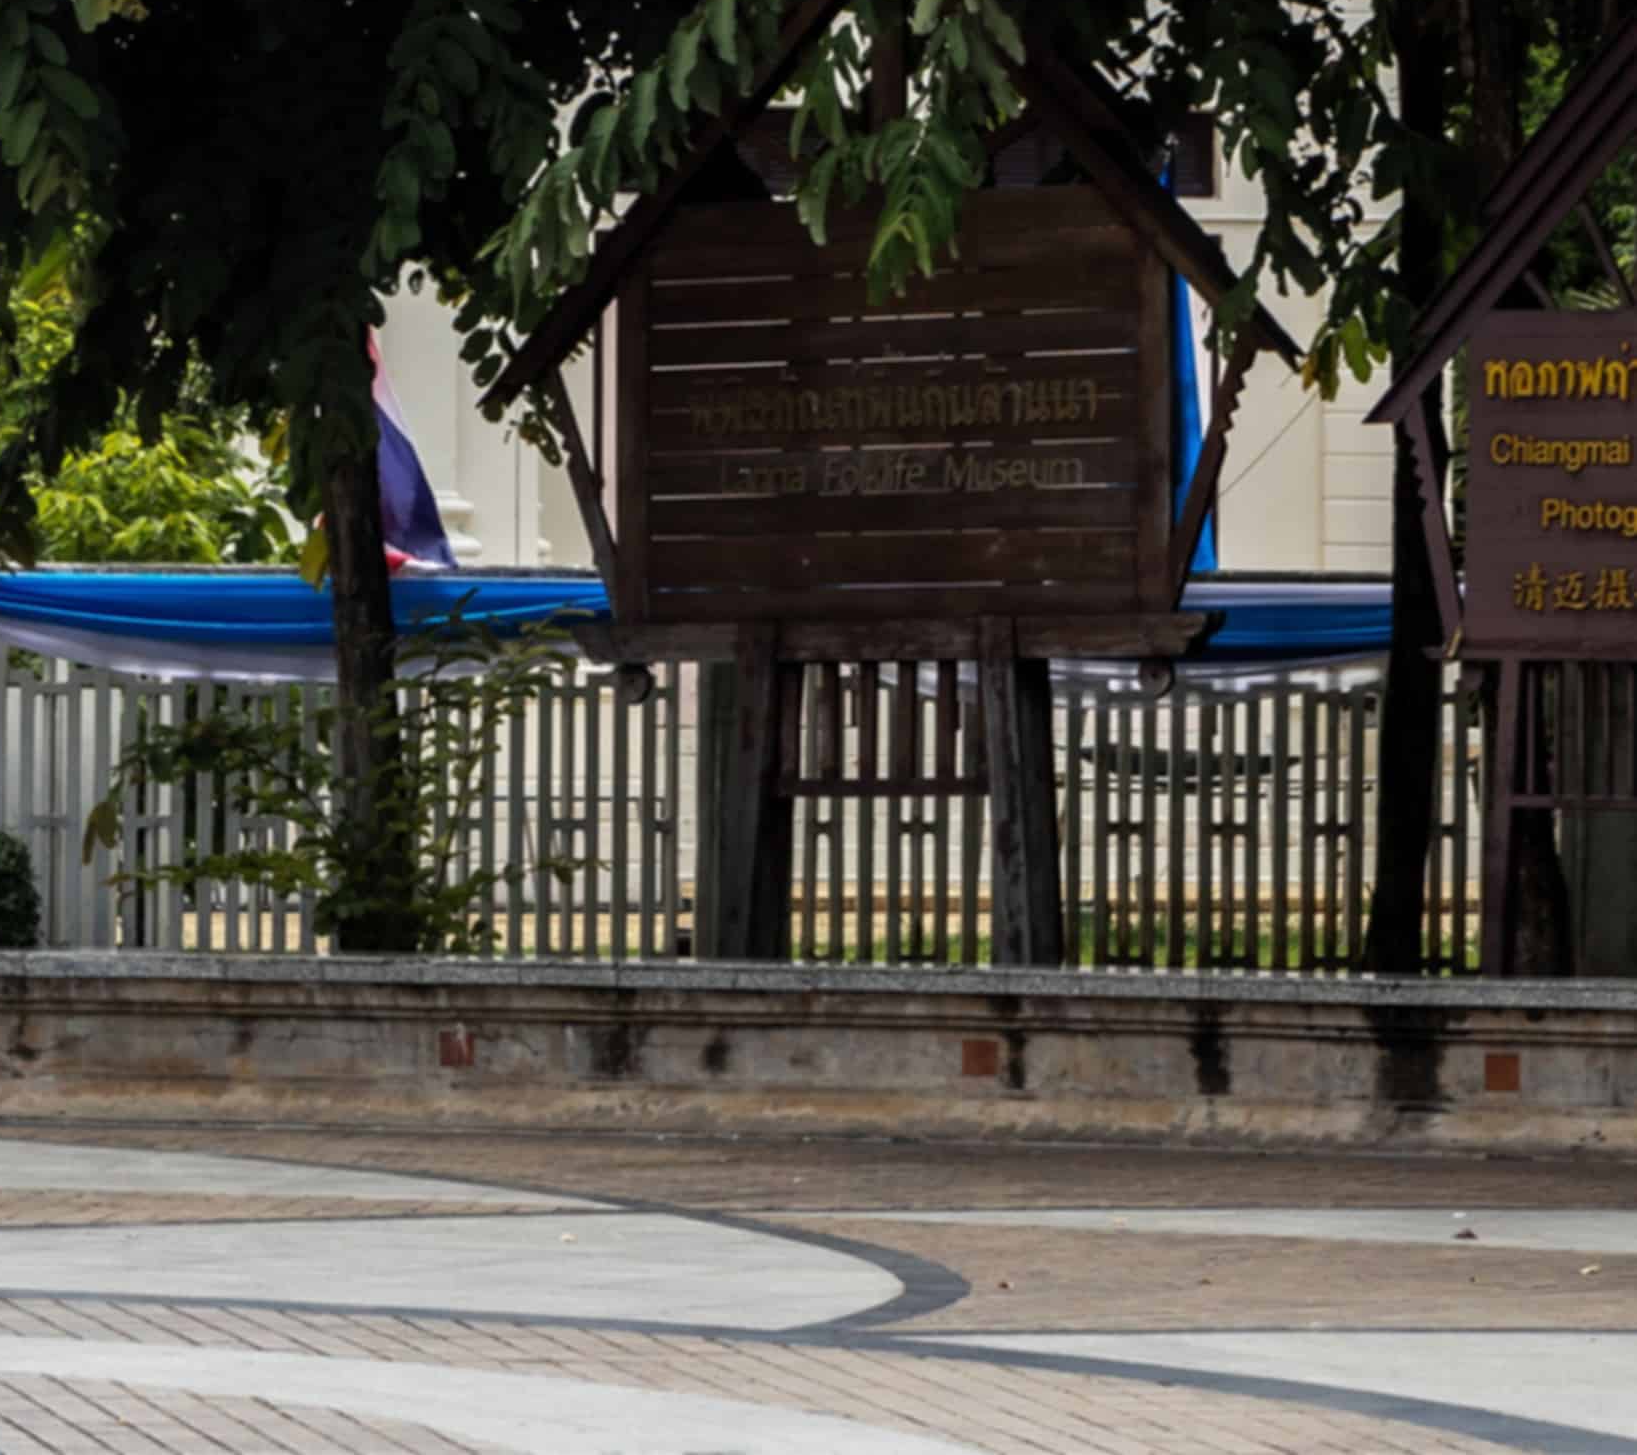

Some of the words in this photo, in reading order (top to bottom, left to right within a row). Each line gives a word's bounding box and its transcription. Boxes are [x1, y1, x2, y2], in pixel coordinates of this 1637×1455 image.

[720, 461, 807, 494] Lanna
[942, 453, 1085, 490] Museum
[1490, 434, 1630, 472] Chiangmai
[1513, 561, 1637, 611] 清迈摄
